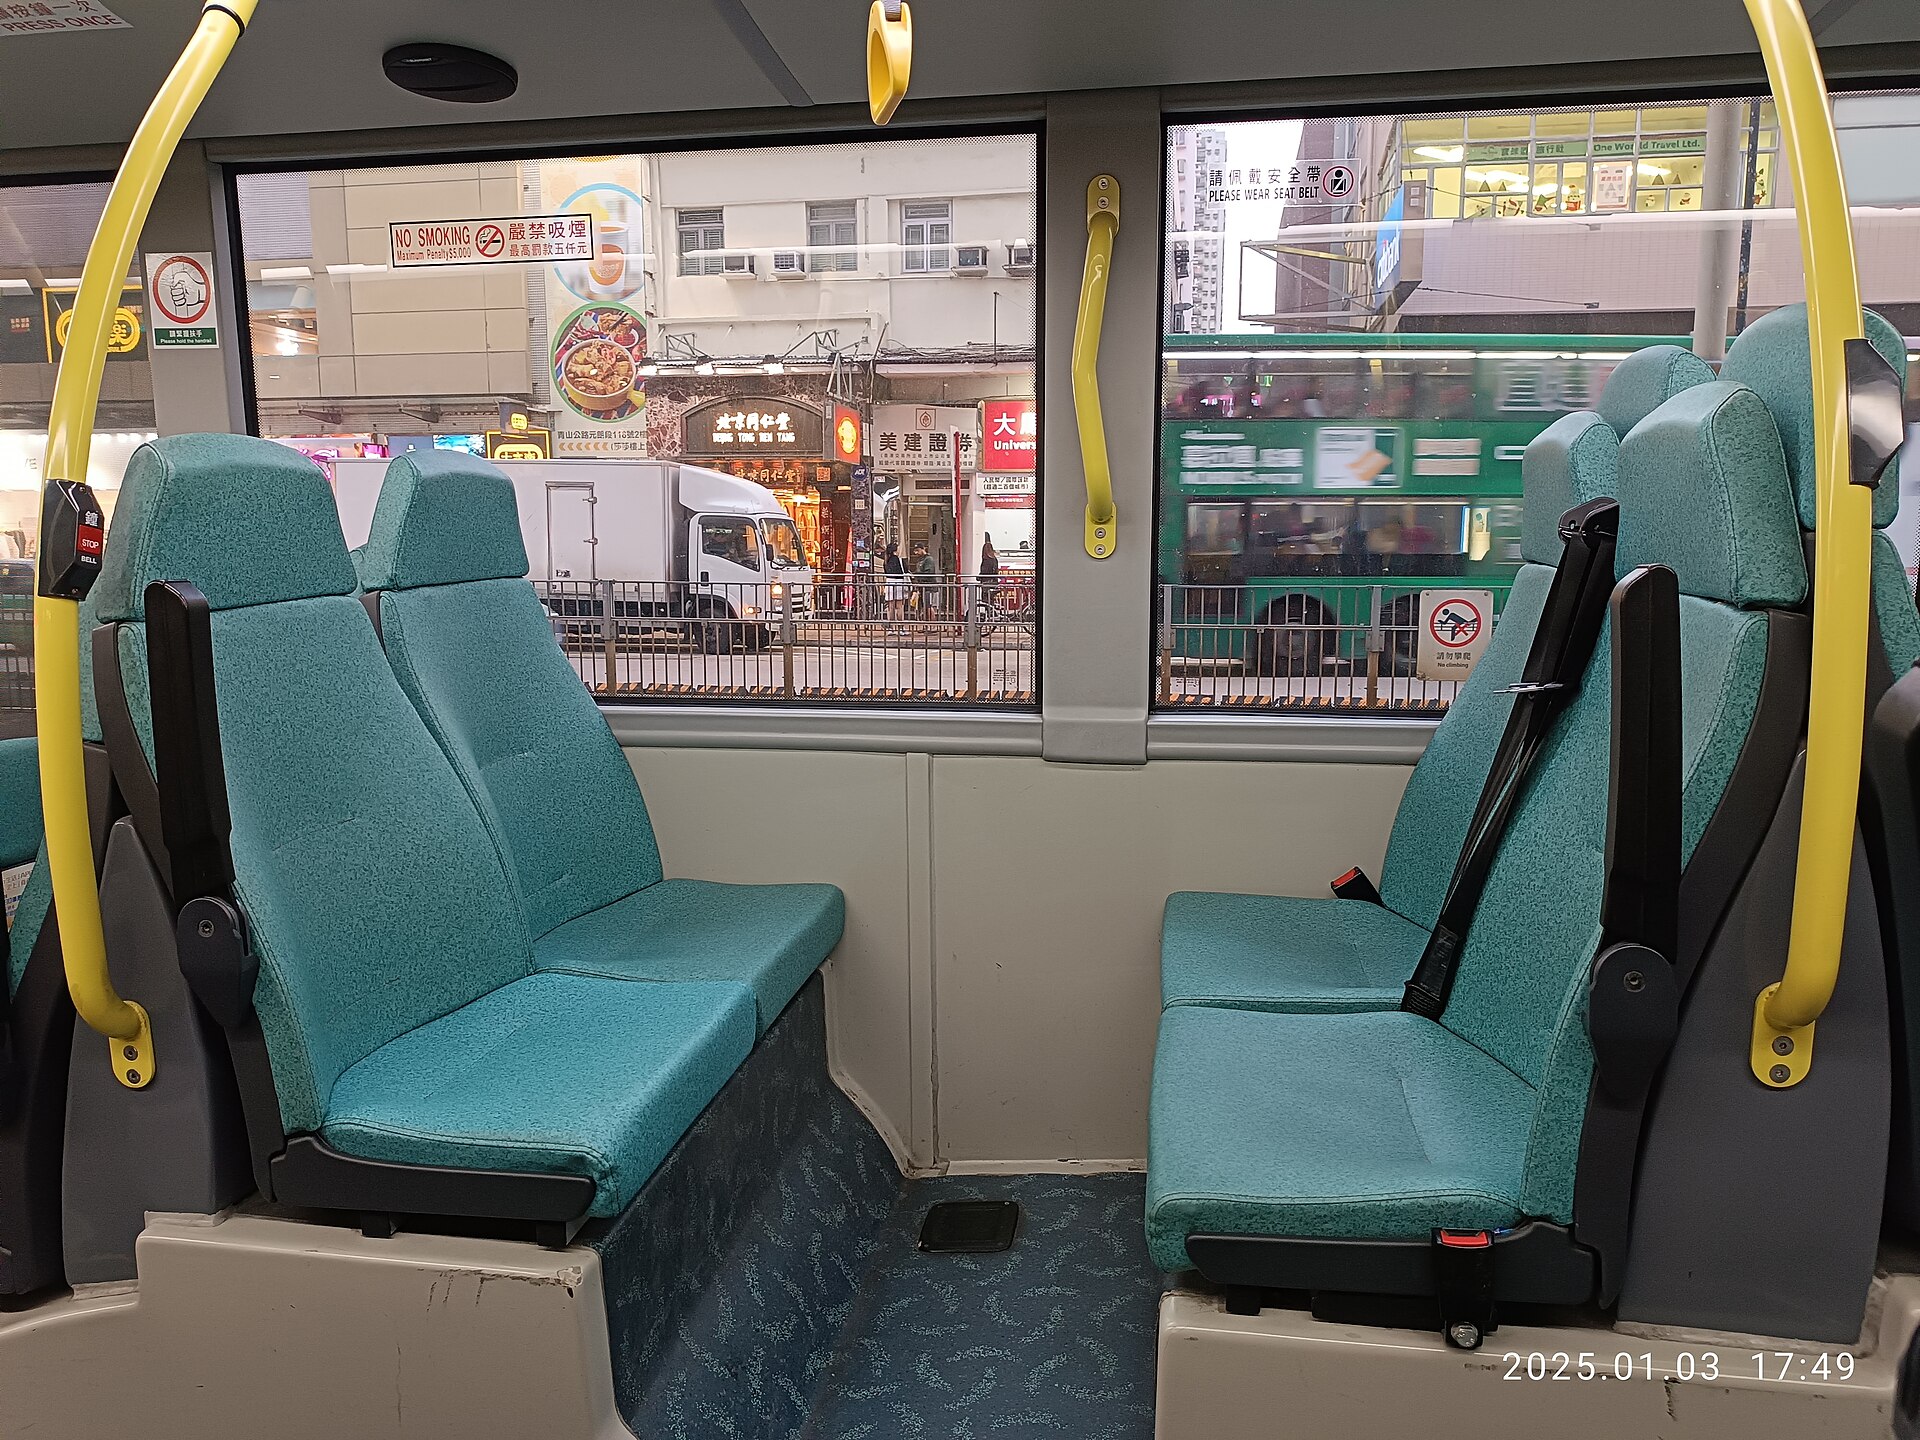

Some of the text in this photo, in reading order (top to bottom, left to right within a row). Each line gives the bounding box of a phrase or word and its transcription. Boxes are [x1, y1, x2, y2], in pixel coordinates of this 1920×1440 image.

[2, 15, 122, 32] PRESS ONCE
[1593, 144, 1612, 152] One
[1652, 140, 1681, 149] Travel
[1682, 140, 1701, 148] Ltd.
[1209, 165, 1321, 187] 請佩戴安全帶
[1209, 185, 1320, 202] PLEASE WEAR SEAT BELT
[395, 225, 471, 247] NO SMOKING
[508, 220, 587, 241] 嚴禁吸煙
[396, 250, 425, 261] Maximum
[509, 242, 588, 257] 最高罰款五仟元
[879, 432, 973, 452] 美建證券
[81, 538, 100, 549] STOP
[81, 555, 97, 565] BELL
[1446, 661, 1469, 669] climbing
